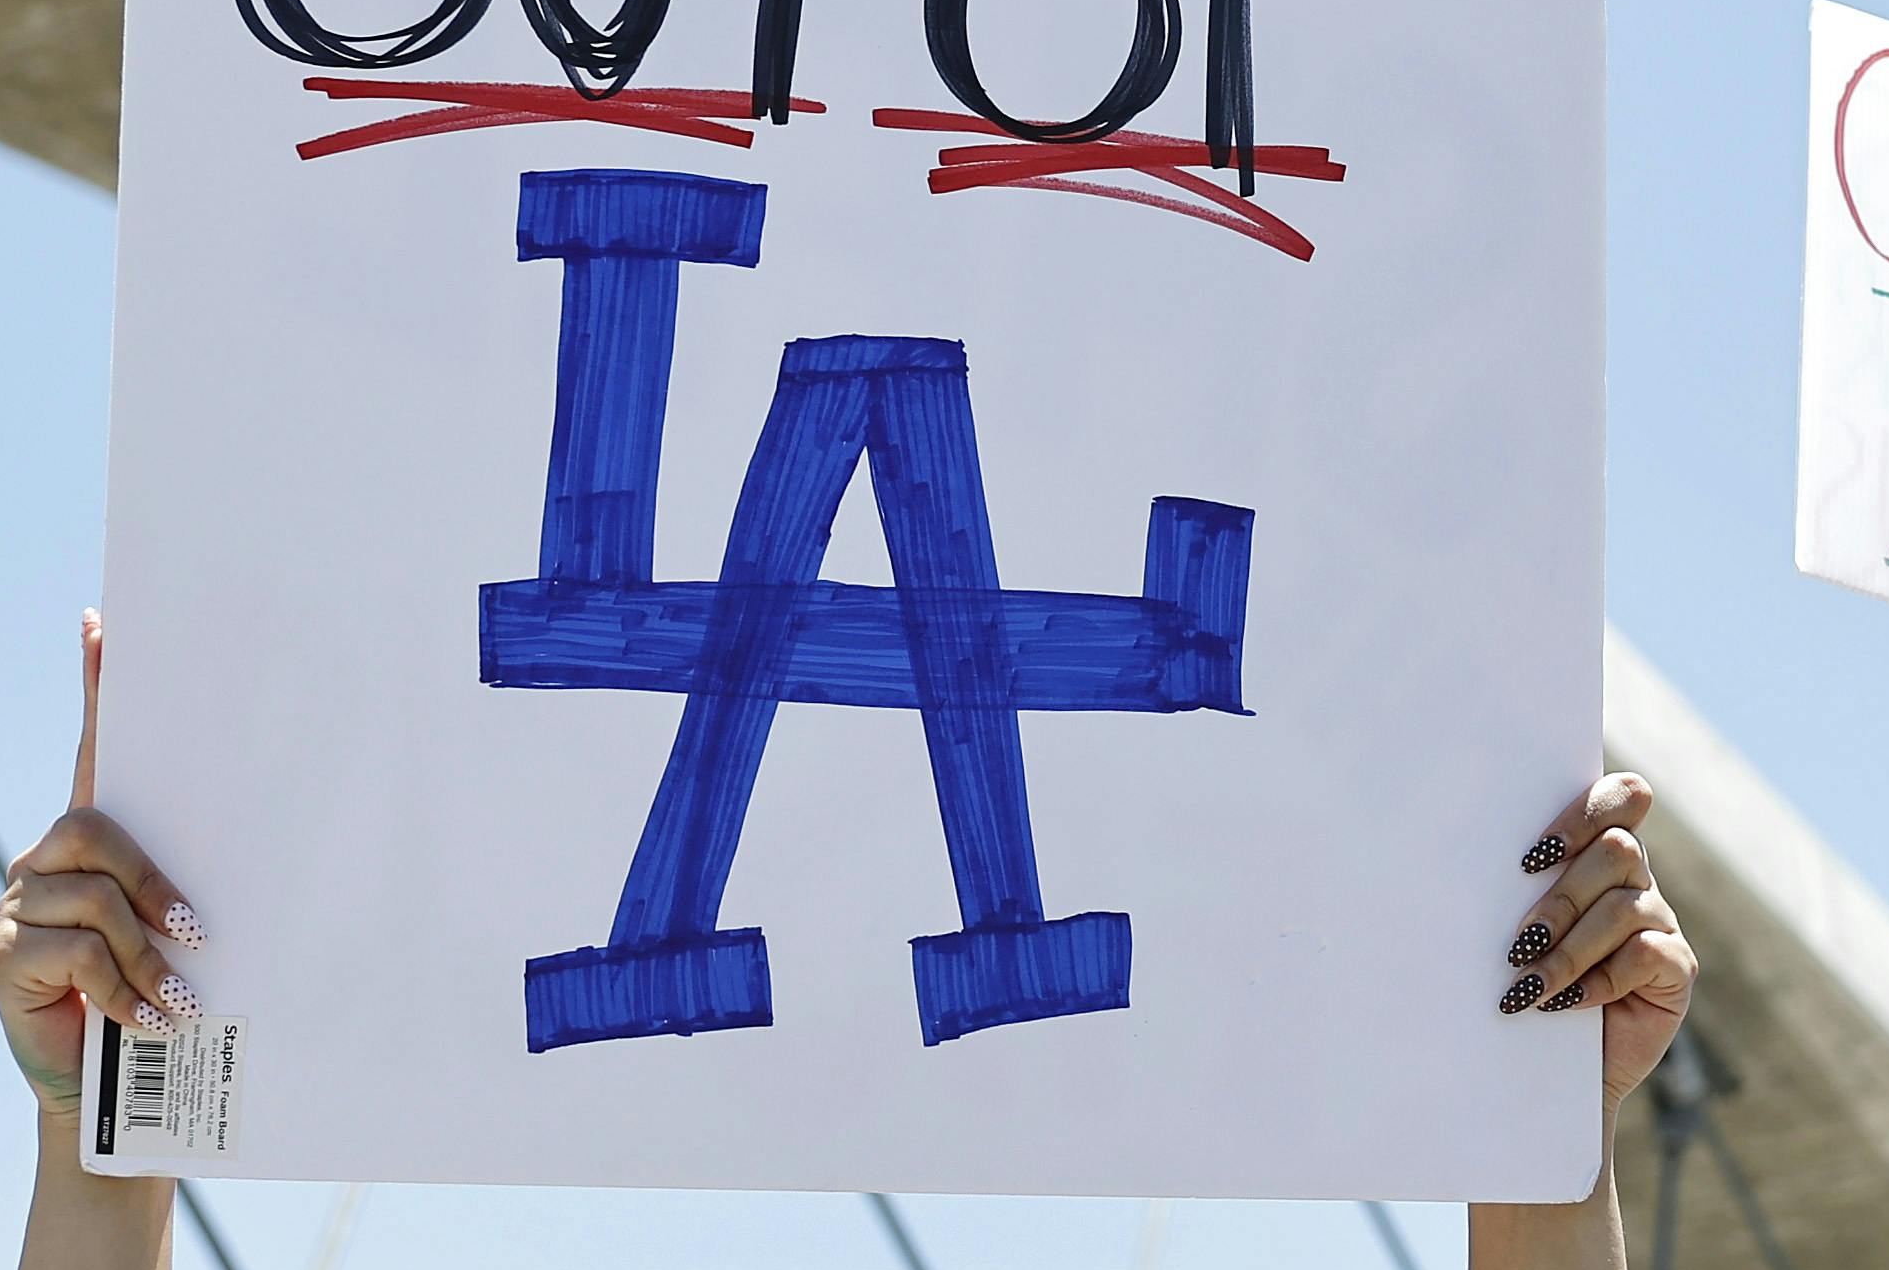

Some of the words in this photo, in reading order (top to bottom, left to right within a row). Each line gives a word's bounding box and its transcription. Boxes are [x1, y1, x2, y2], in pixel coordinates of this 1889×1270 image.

[478, 168, 1257, 1054] LA
[220, 1091, 229, 1118] Foam
[218, 1121, 227, 1150] Board
